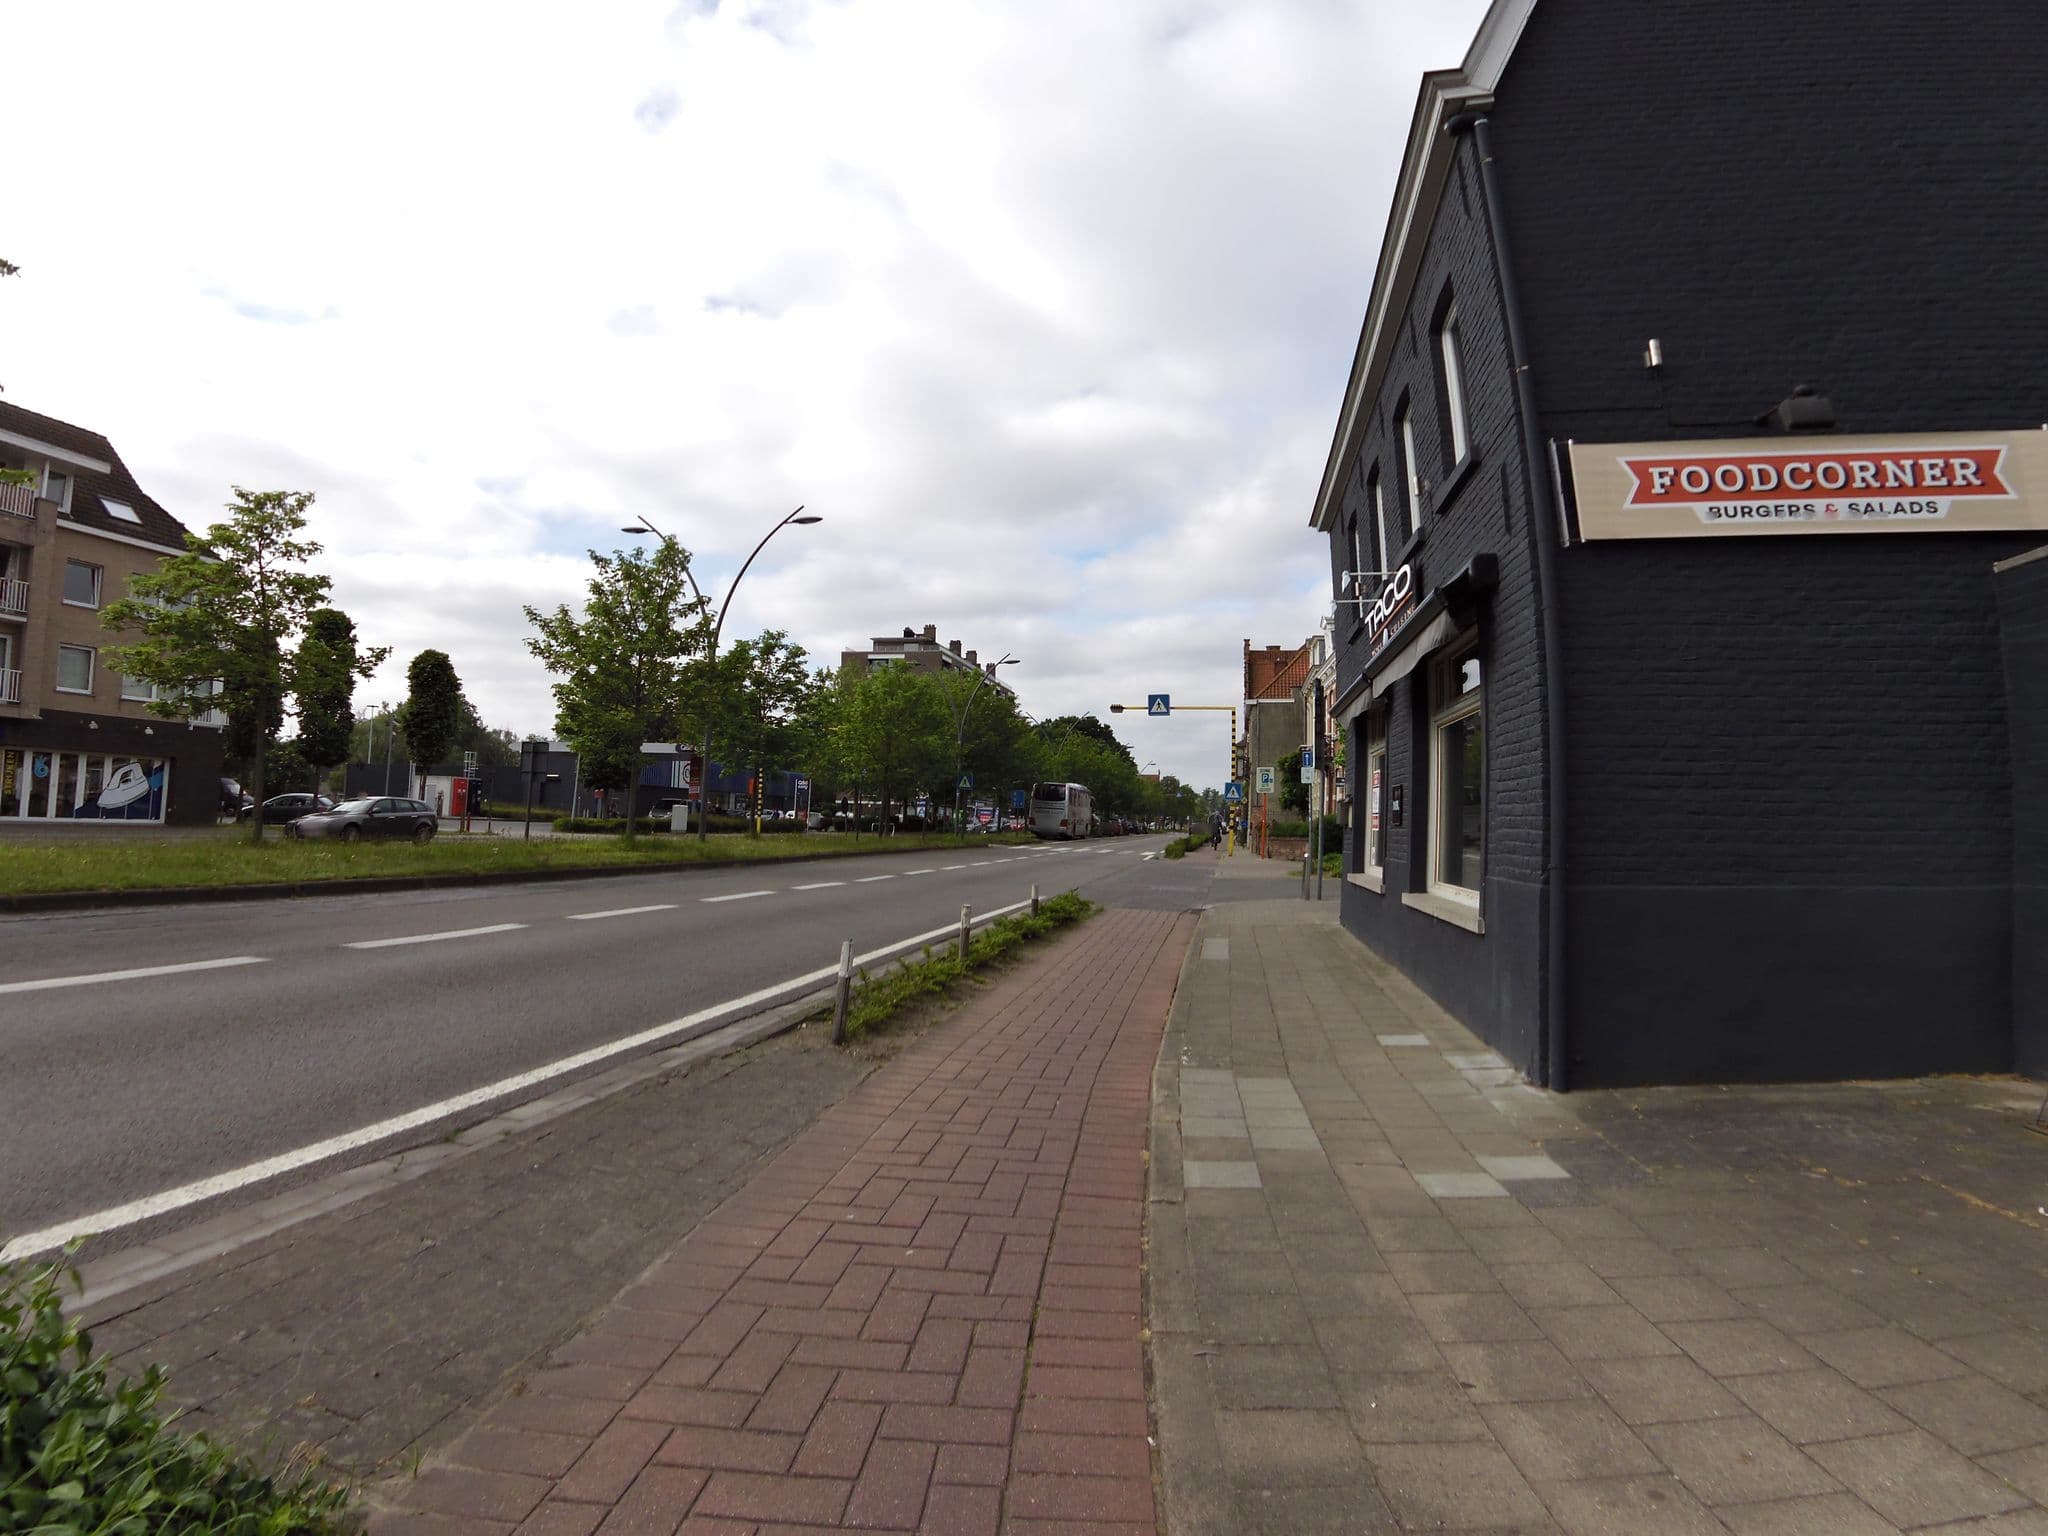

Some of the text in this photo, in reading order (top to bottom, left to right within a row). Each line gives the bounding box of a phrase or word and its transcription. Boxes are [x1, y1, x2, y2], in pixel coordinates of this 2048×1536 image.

[1648, 457, 1984, 495] FOODCORNER
[1847, 501, 1939, 515] SALADS
[1364, 564, 1411, 638] TACO
